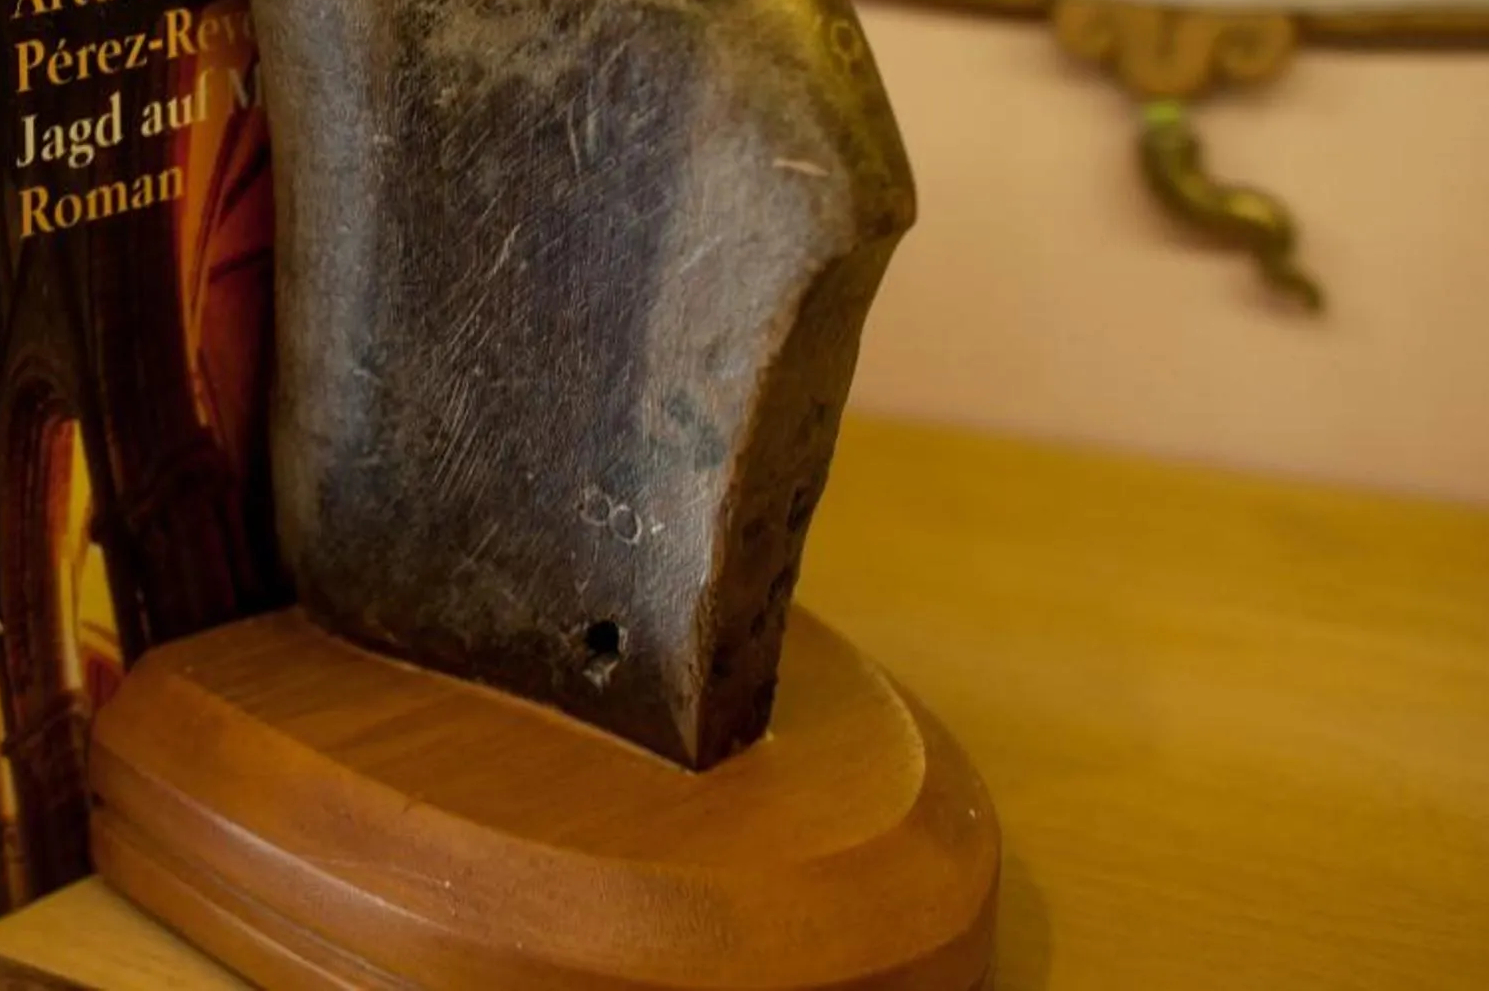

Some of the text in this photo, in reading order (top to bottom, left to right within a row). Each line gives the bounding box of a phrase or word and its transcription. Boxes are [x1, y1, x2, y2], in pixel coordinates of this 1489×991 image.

[16, 90, 124, 169] Jagd
[140, 67, 214, 138] auf
[18, 166, 185, 238] Roman
